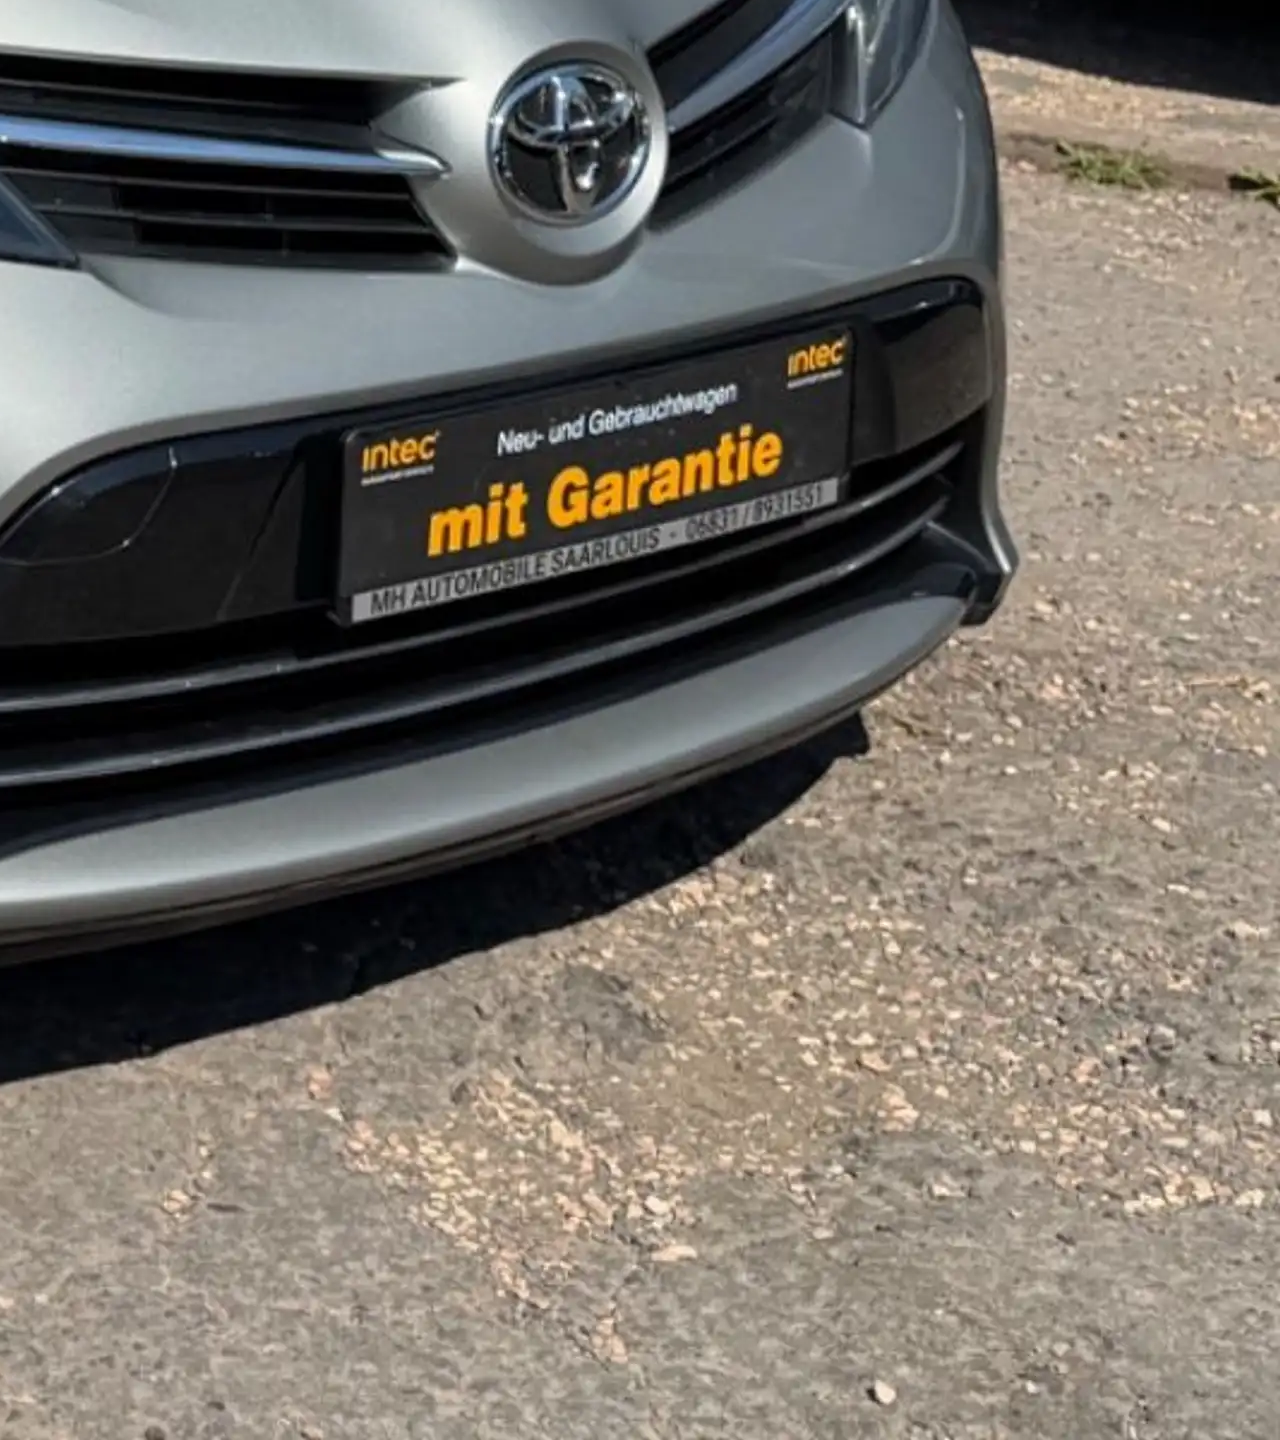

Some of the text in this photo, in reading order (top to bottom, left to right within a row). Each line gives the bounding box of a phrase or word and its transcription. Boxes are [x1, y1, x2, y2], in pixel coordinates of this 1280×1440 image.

[361, 434, 437, 473] intec
[497, 382, 738, 456] Neu- und Gebrauchtwagen
[428, 422, 783, 557] mit Garantie
[370, 587, 407, 615] MH
[411, 555, 546, 608] AUTOMOBILE
[549, 527, 661, 575] SAARLOUIS
